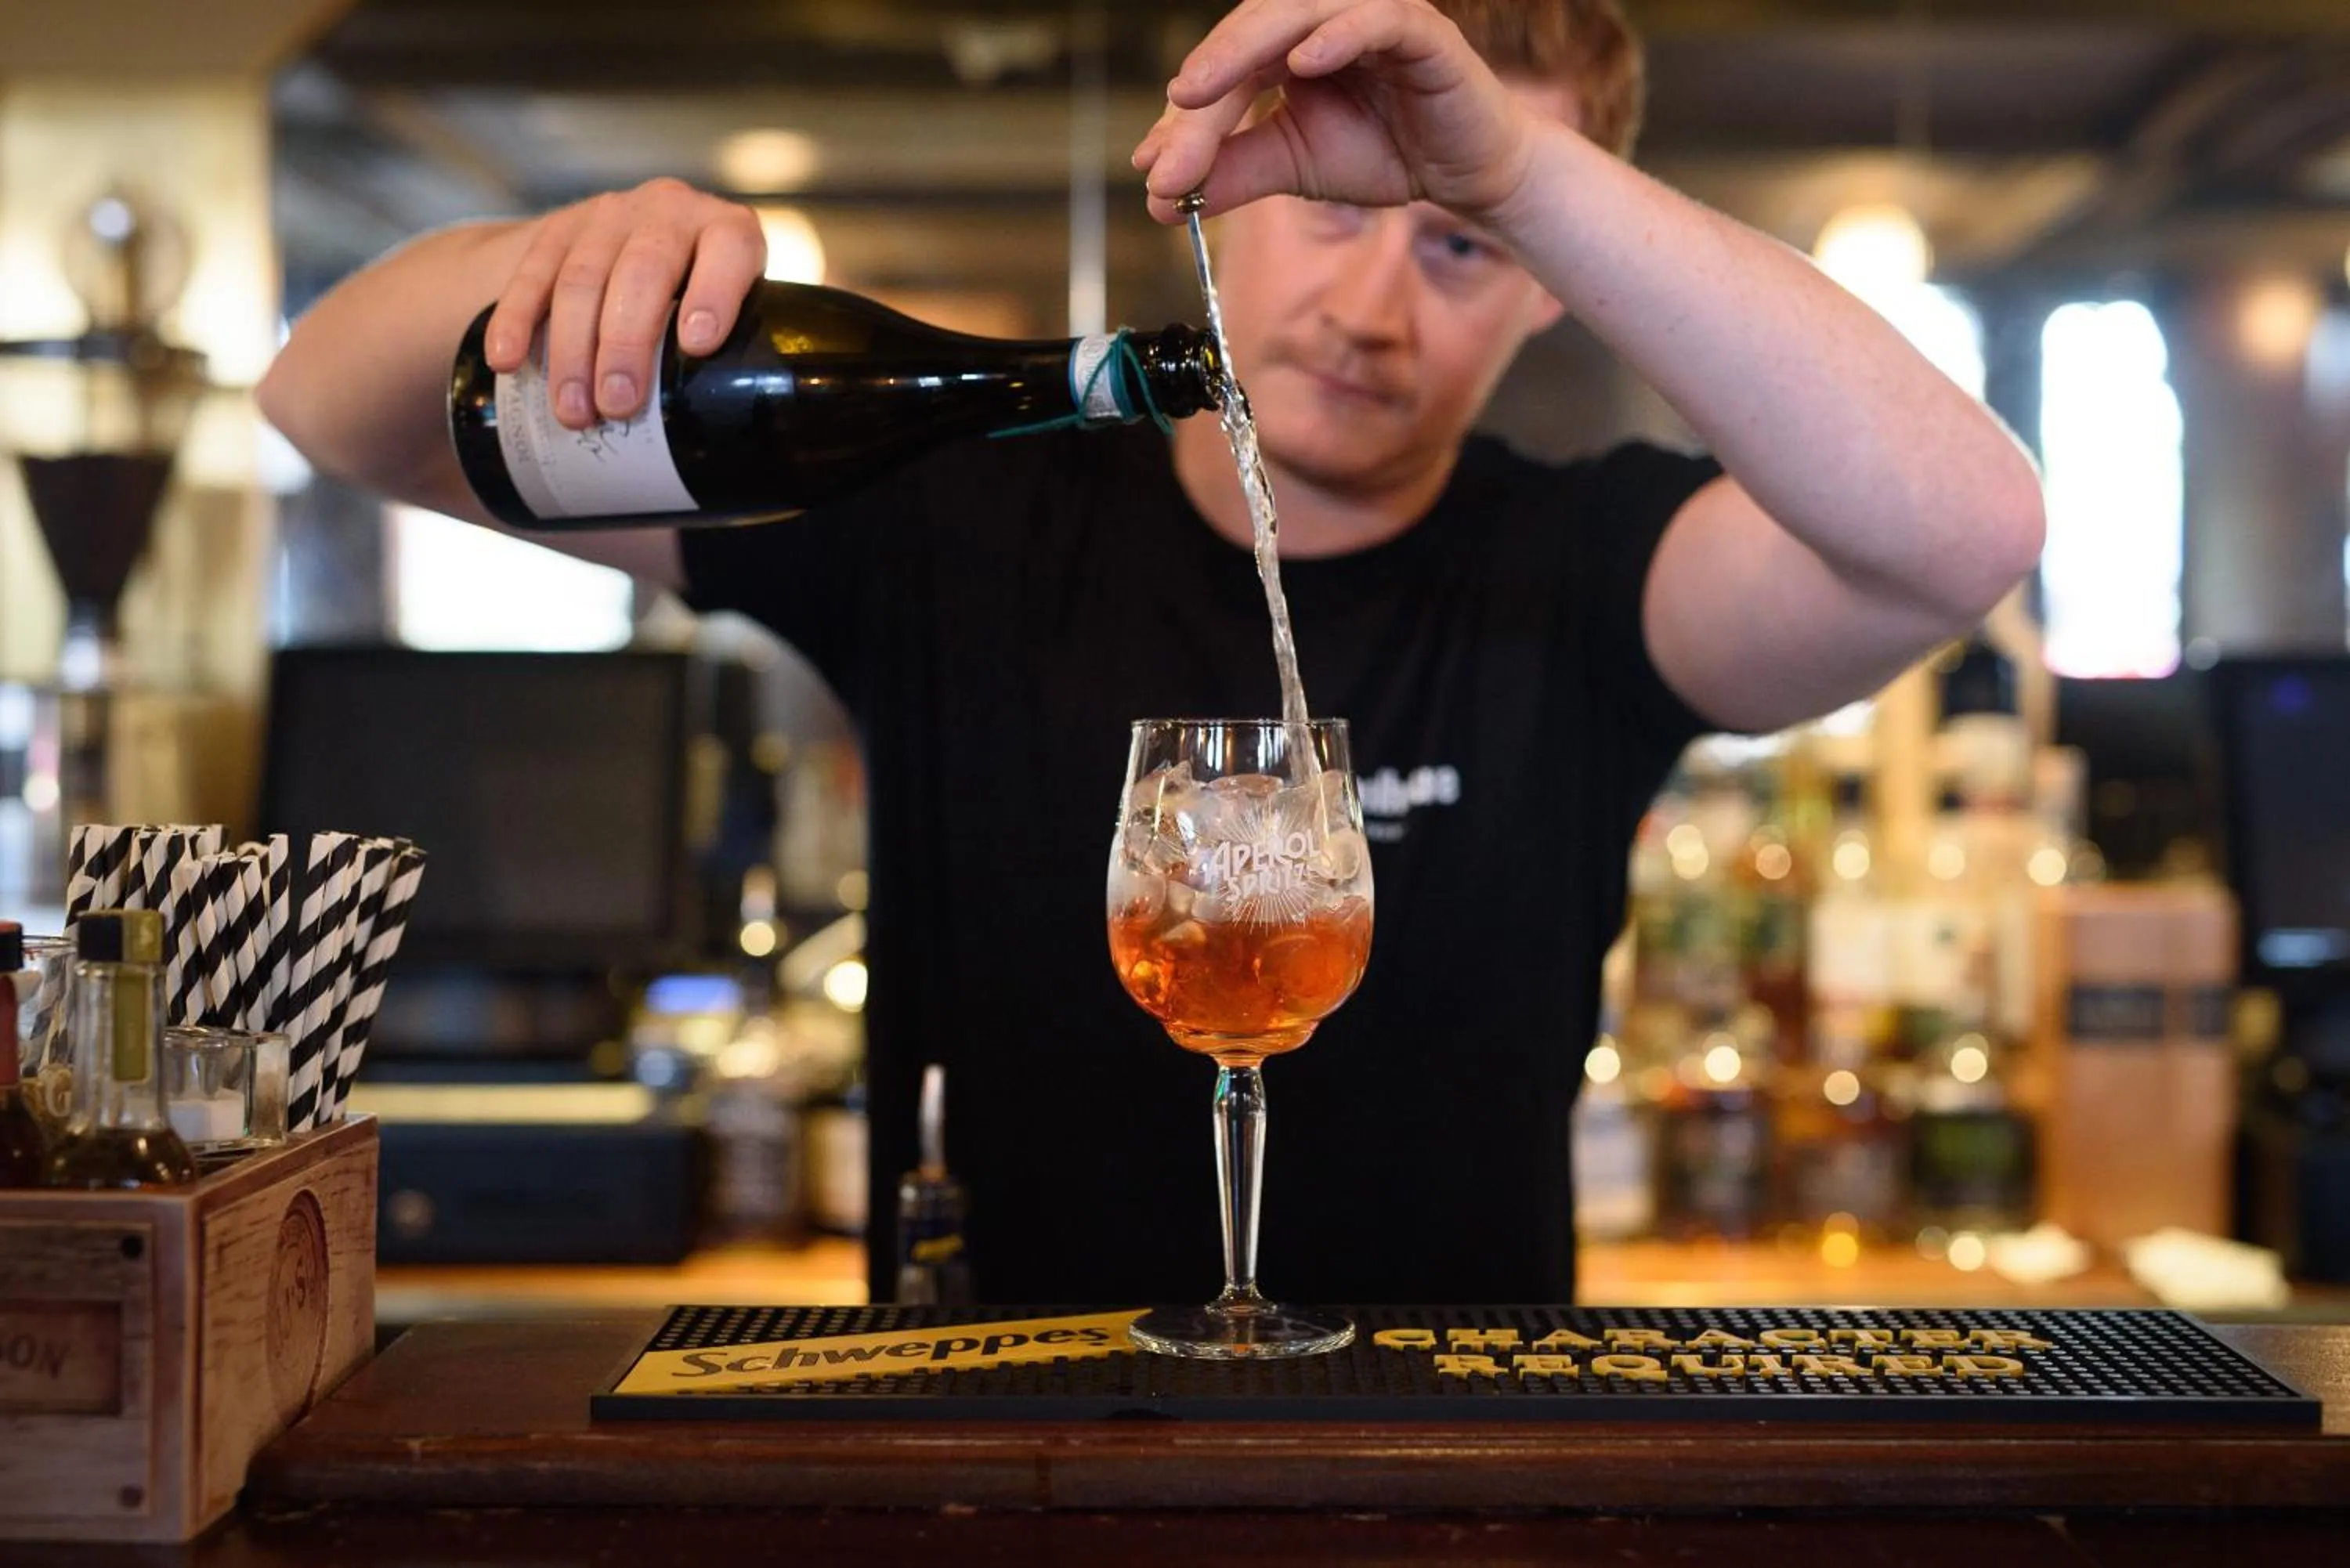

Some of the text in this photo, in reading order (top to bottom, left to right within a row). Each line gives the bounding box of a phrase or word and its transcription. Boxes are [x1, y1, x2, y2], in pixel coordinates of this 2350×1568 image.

[1204, 829, 1321, 885] APEROL
[1225, 862, 1309, 901] SPRITZ
[0, 1332, 73, 1379] ON
[671, 1327, 1109, 1378] Schweppes
[1373, 1328, 2054, 1354] CHARACTER
[1434, 1353, 2024, 1382] REQUIRED
